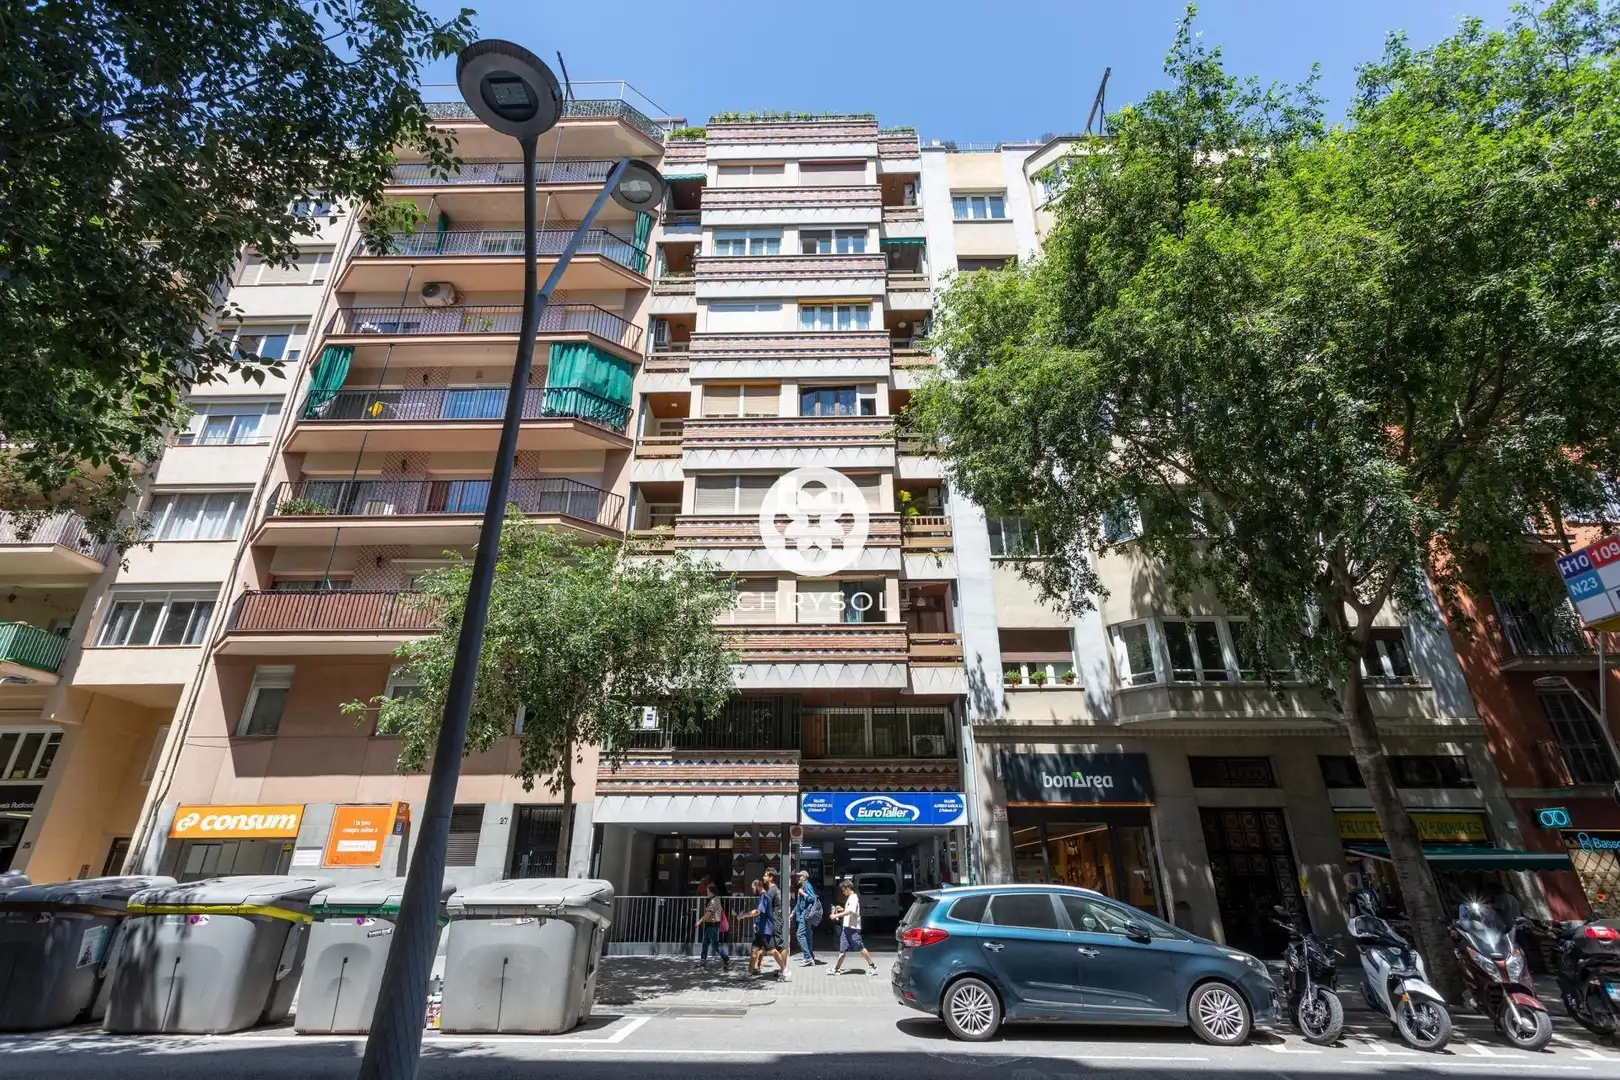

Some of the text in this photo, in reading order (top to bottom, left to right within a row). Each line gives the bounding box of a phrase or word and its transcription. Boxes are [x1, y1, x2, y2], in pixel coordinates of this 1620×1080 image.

[1560, 542, 1620, 575] H10 109
[1570, 577, 1598, 596] N23
[857, 806, 909, 818] EuroTaller
[200, 813, 297, 831] consum
